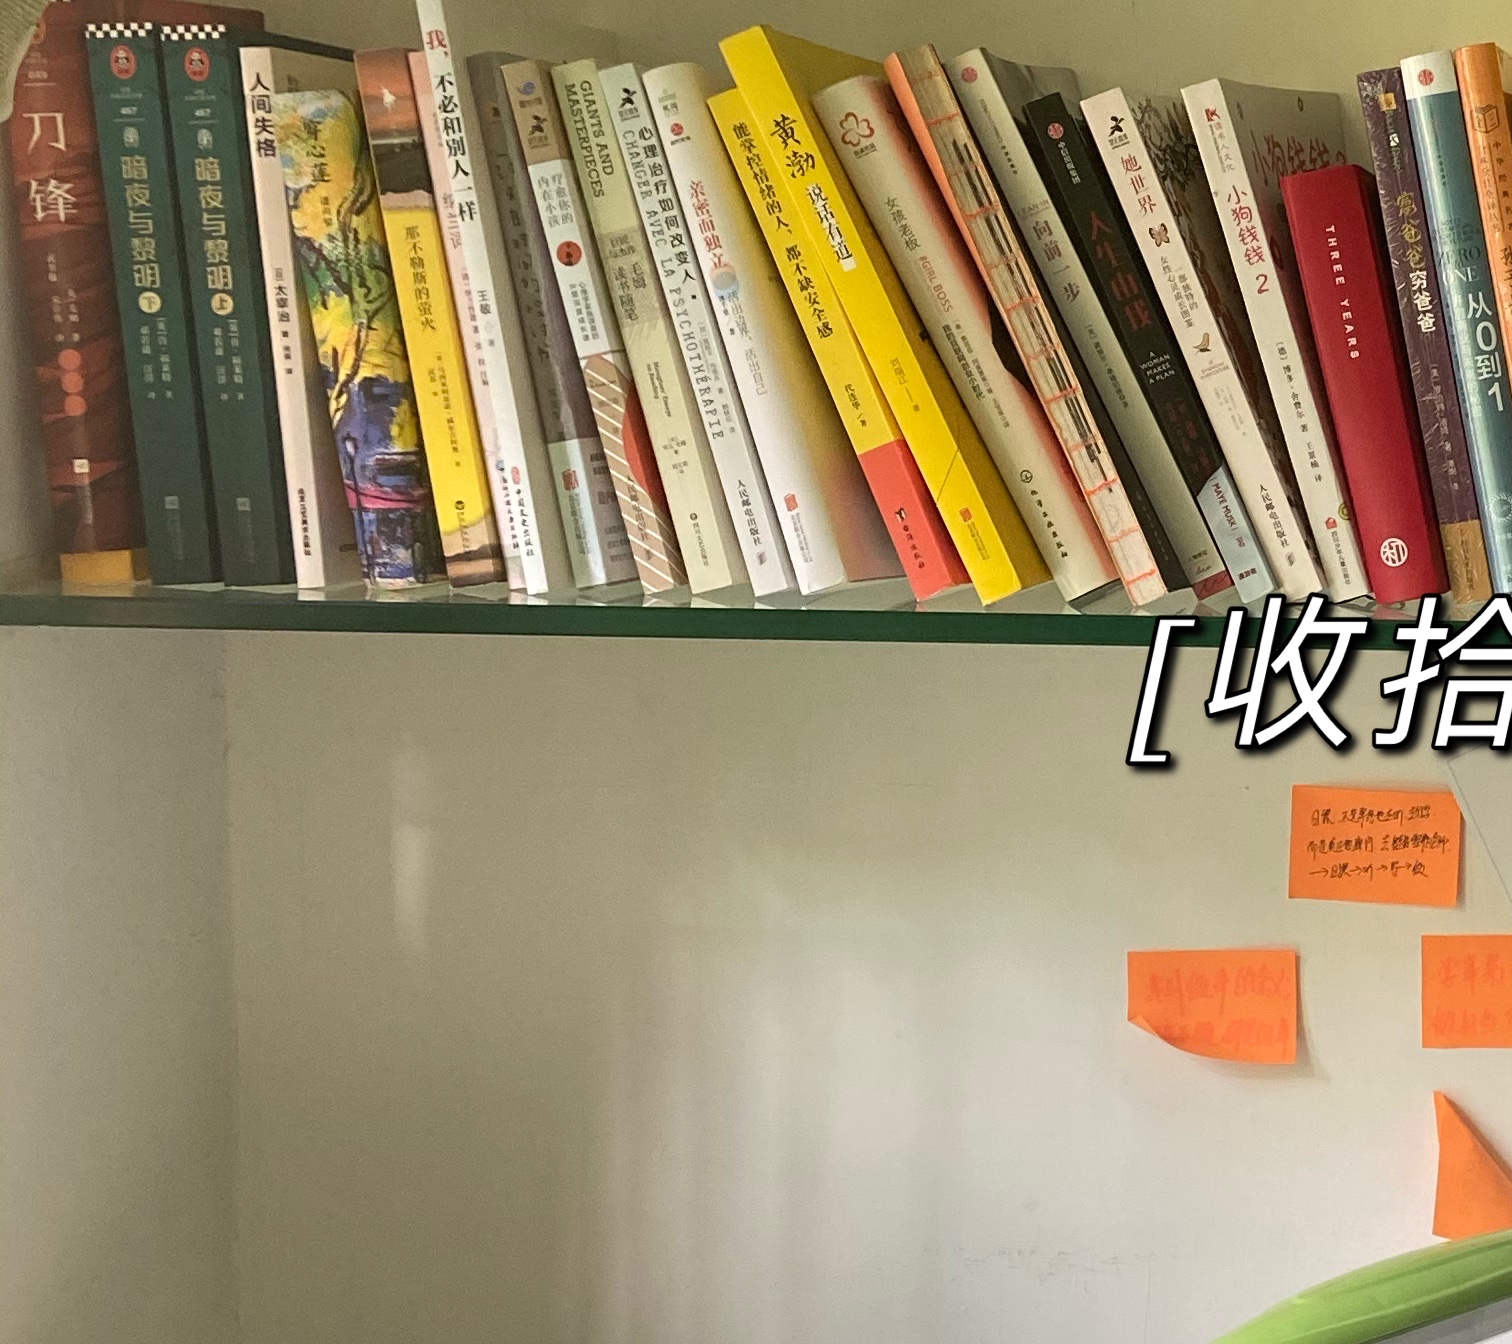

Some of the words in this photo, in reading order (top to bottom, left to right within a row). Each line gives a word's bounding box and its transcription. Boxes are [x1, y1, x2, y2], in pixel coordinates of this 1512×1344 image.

[249, 71, 277, 159] 人间失格
[564, 82, 605, 198] MASTERPIECES
[580, 80, 603, 140] GIANTS
[597, 143, 614, 177] AND
[770, 113, 817, 180] 黄渤
[22, 110, 79, 223] 刀锋
[622, 130, 653, 201] CHANGER
[646, 209, 668, 248] AVEC
[1120, 154, 1157, 216] 她世界
[689, 179, 724, 270] 亲密而独立
[805, 181, 854, 263] 说话有道
[886, 195, 922, 252] 女孩老板
[1031, 218, 1081, 306] 向前一步
[1227, 184, 1267, 266] 小狗钱钱
[1255, 273, 1269, 295] 2
[785, 243, 834, 340] 都不缺安全感
[1088, 210, 1151, 333] 人生由我
[1324, 224, 1346, 286] THREE
[1338, 298, 1360, 359] YEARS
[1466, 290, 1504, 412] 从0到1
